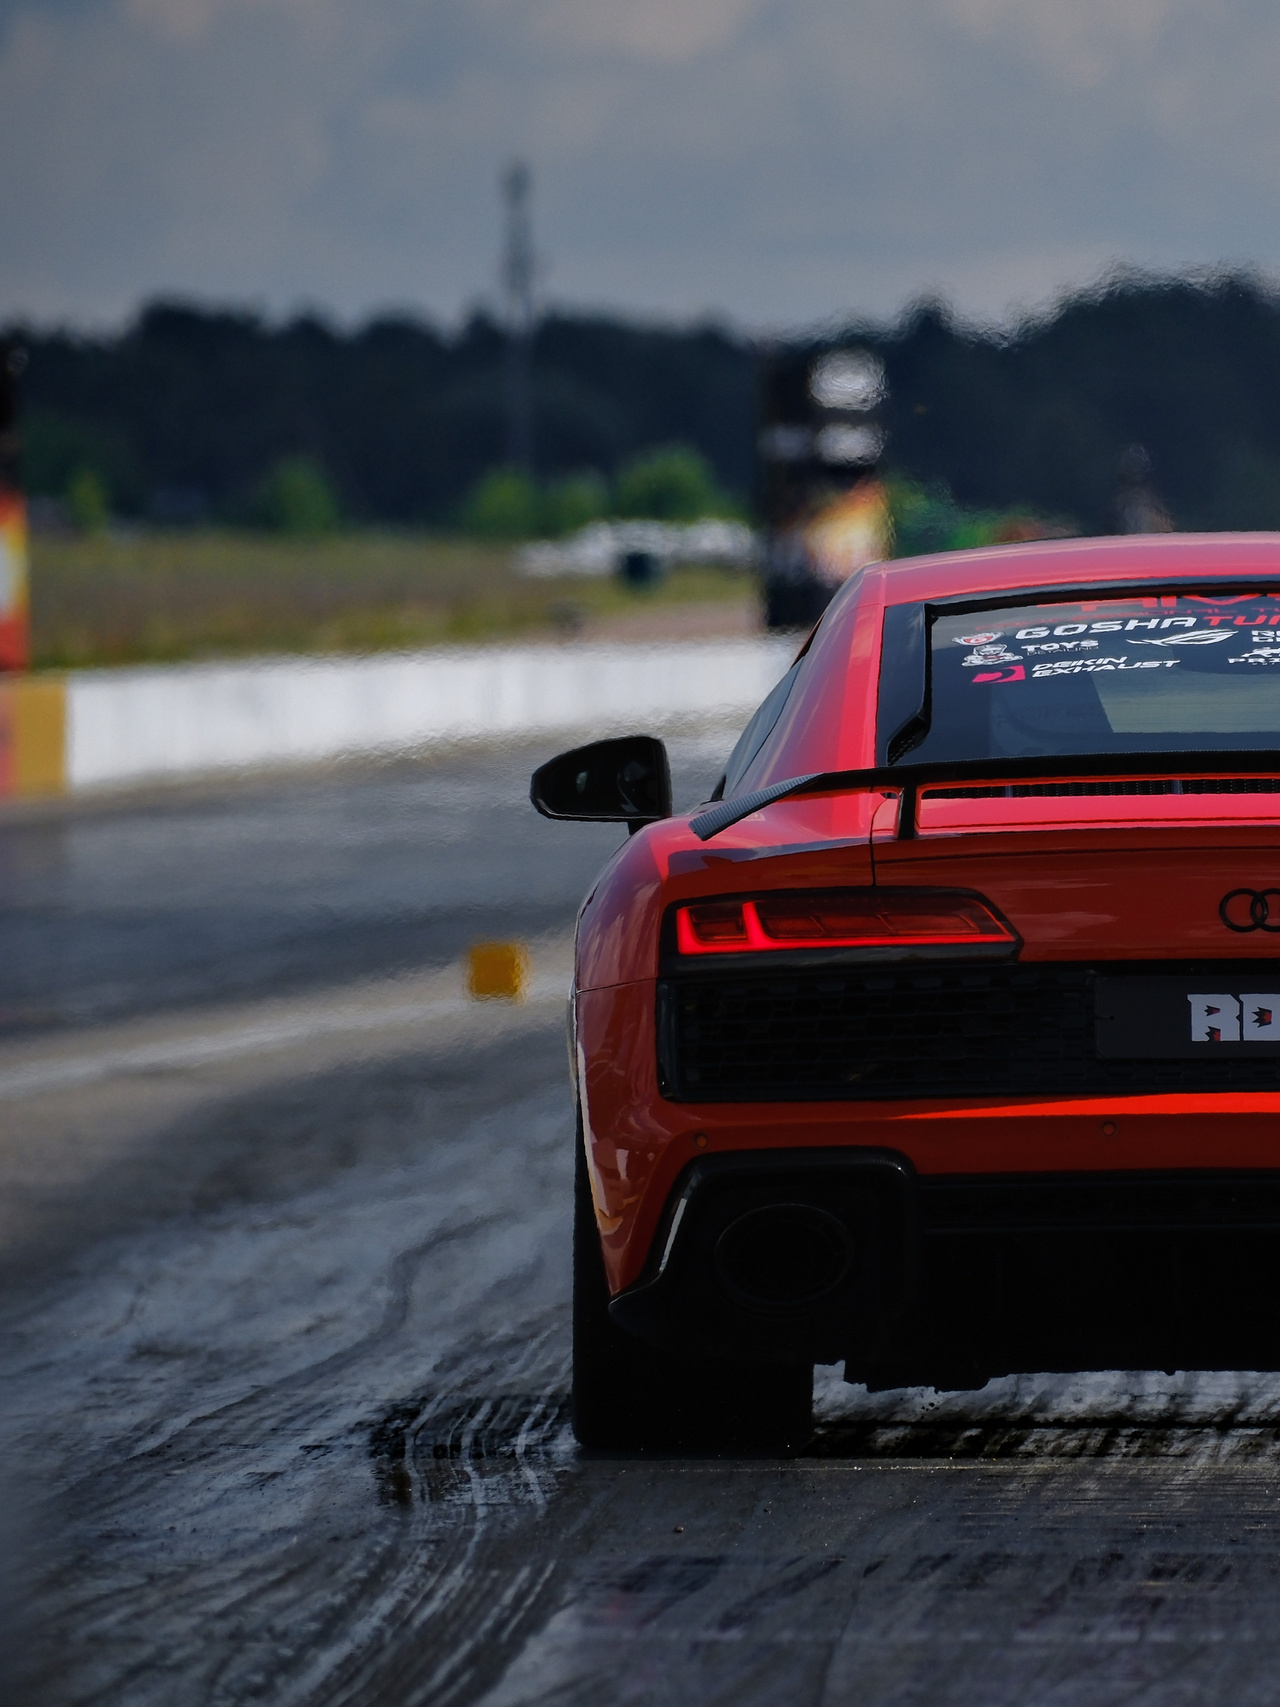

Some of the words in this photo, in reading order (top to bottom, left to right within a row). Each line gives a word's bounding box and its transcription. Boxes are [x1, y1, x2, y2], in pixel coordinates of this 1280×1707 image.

[1015, 616, 1197, 640] GOSHA
[1021, 639, 1099, 653] TOYS
[1032, 656, 1127, 672] DEIKIN
[1032, 659, 1181, 678] EXHAUST
